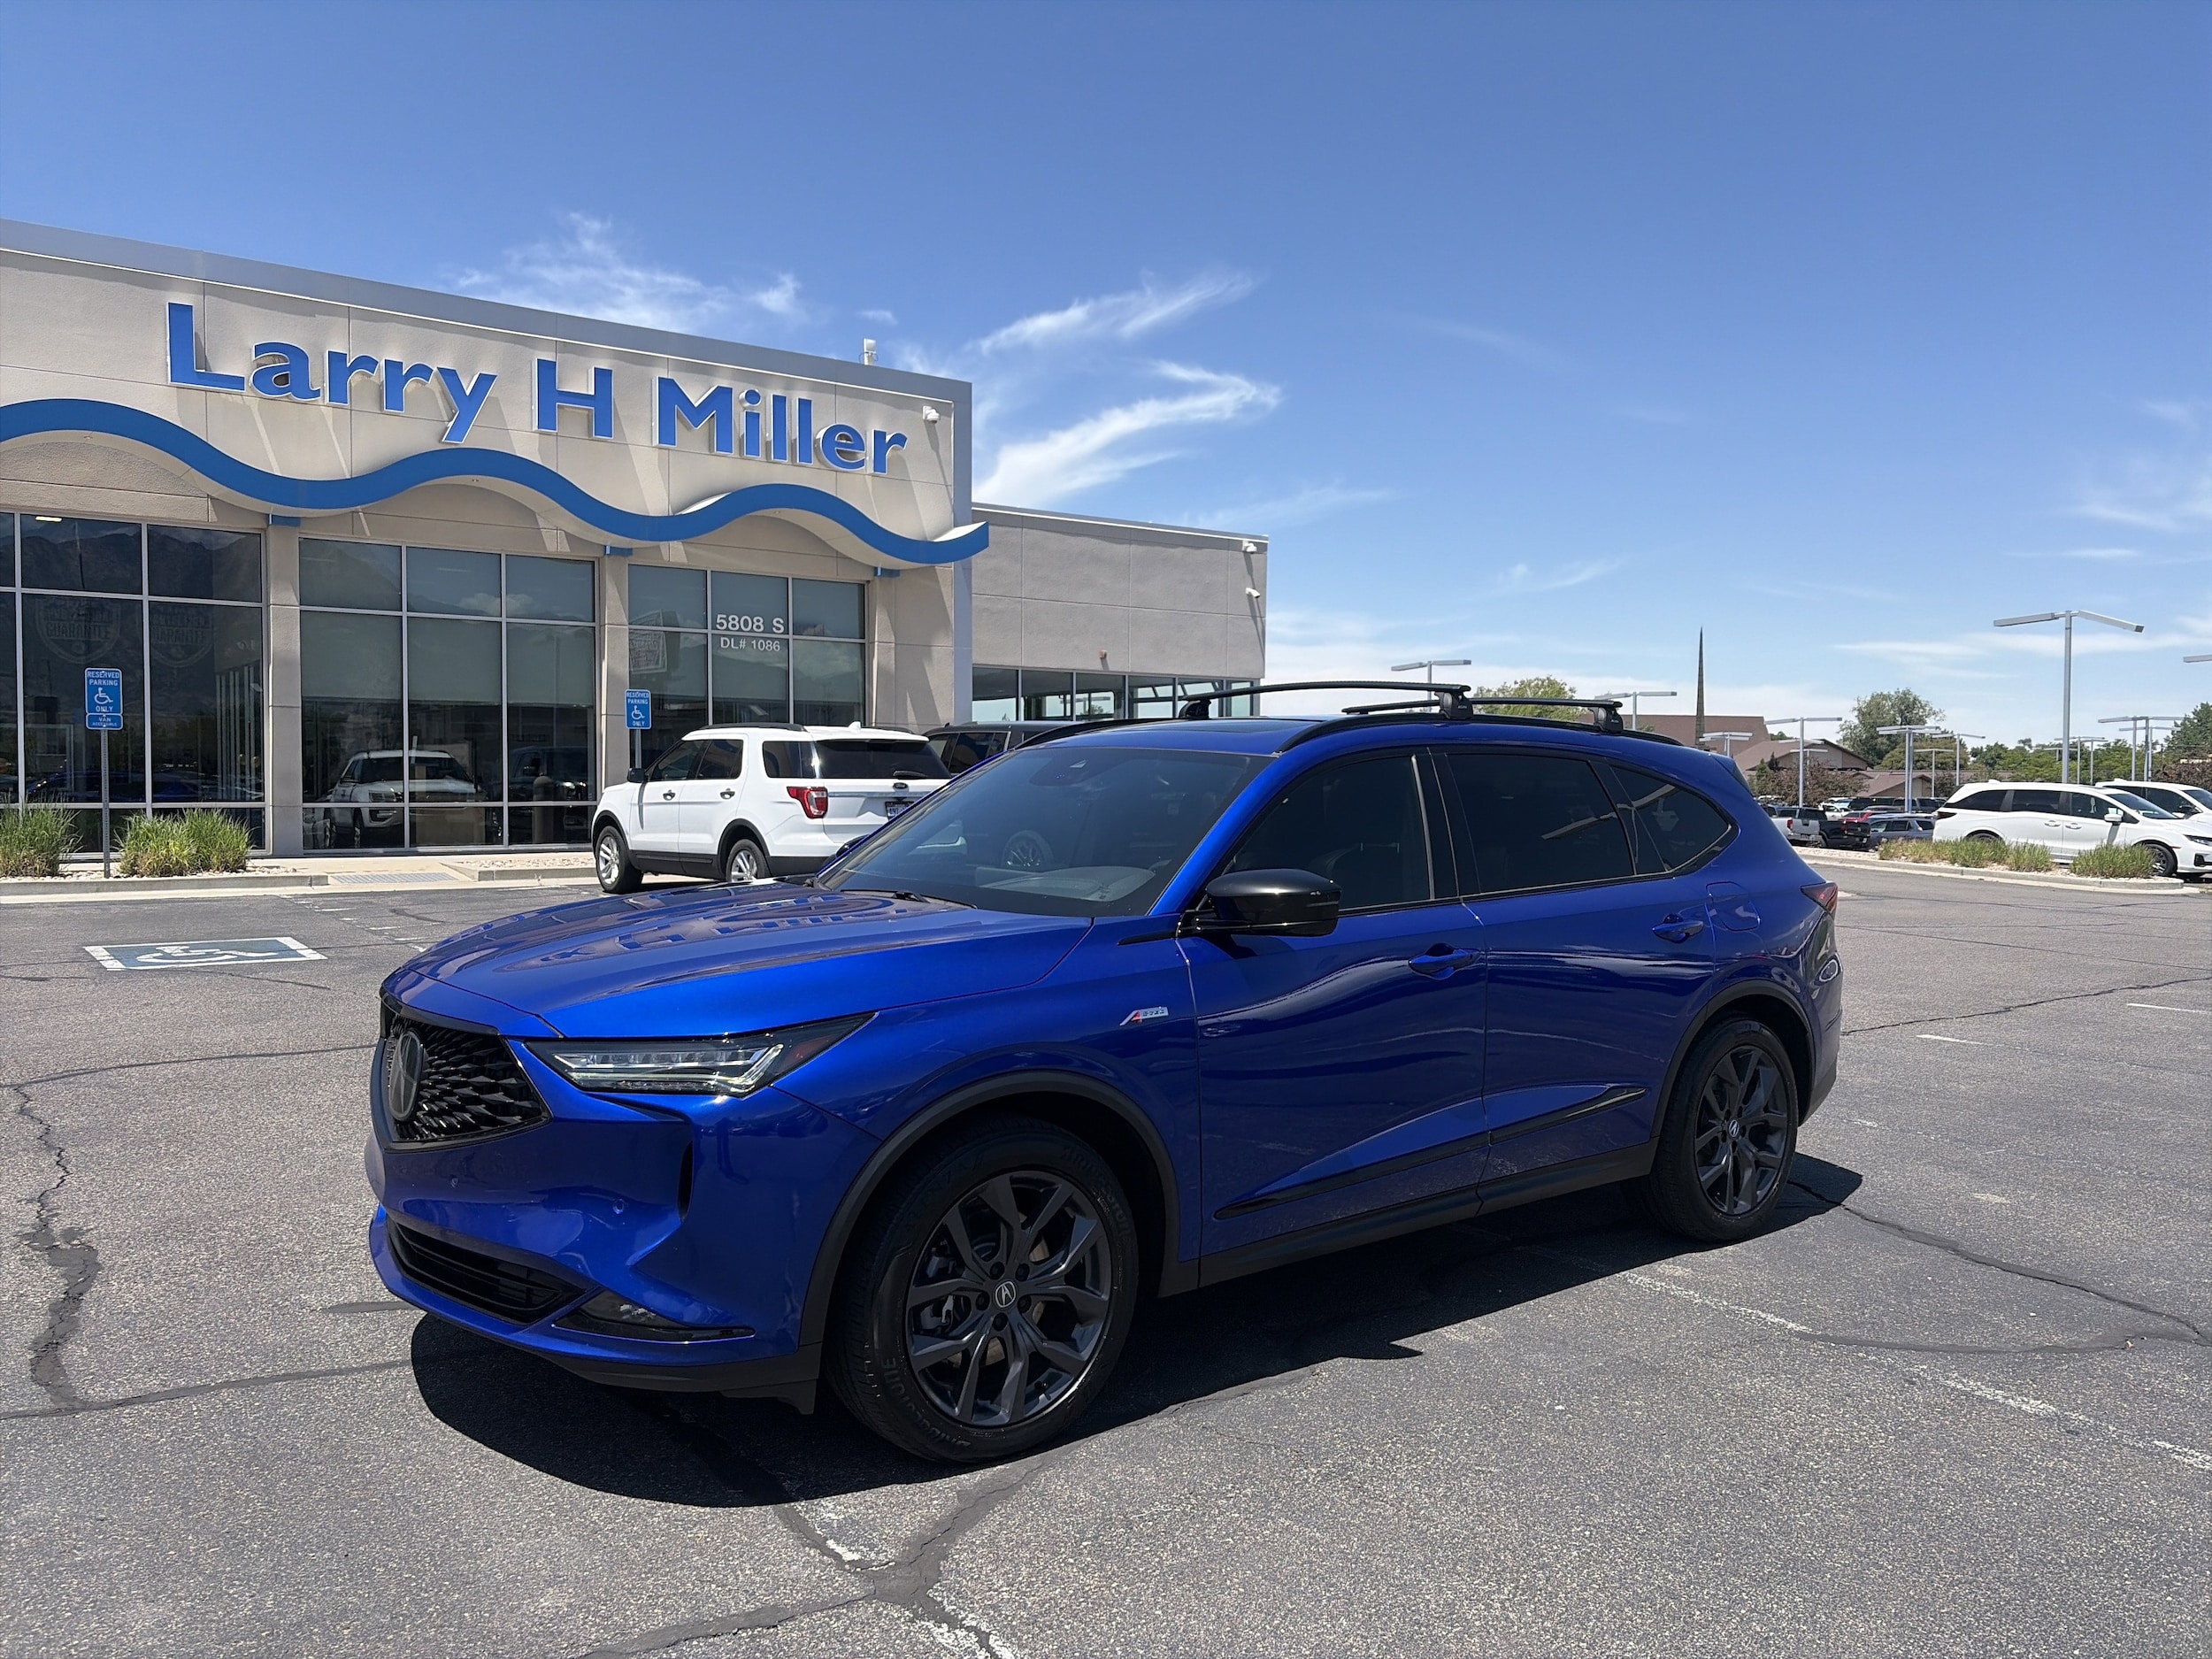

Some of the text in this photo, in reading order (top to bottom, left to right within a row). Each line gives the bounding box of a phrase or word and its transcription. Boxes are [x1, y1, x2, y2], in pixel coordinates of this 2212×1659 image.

[167, 302, 908, 474] Larry H Miller
[716, 614, 785, 634] 5808 S
[720, 637, 780, 652] DL# 1086
